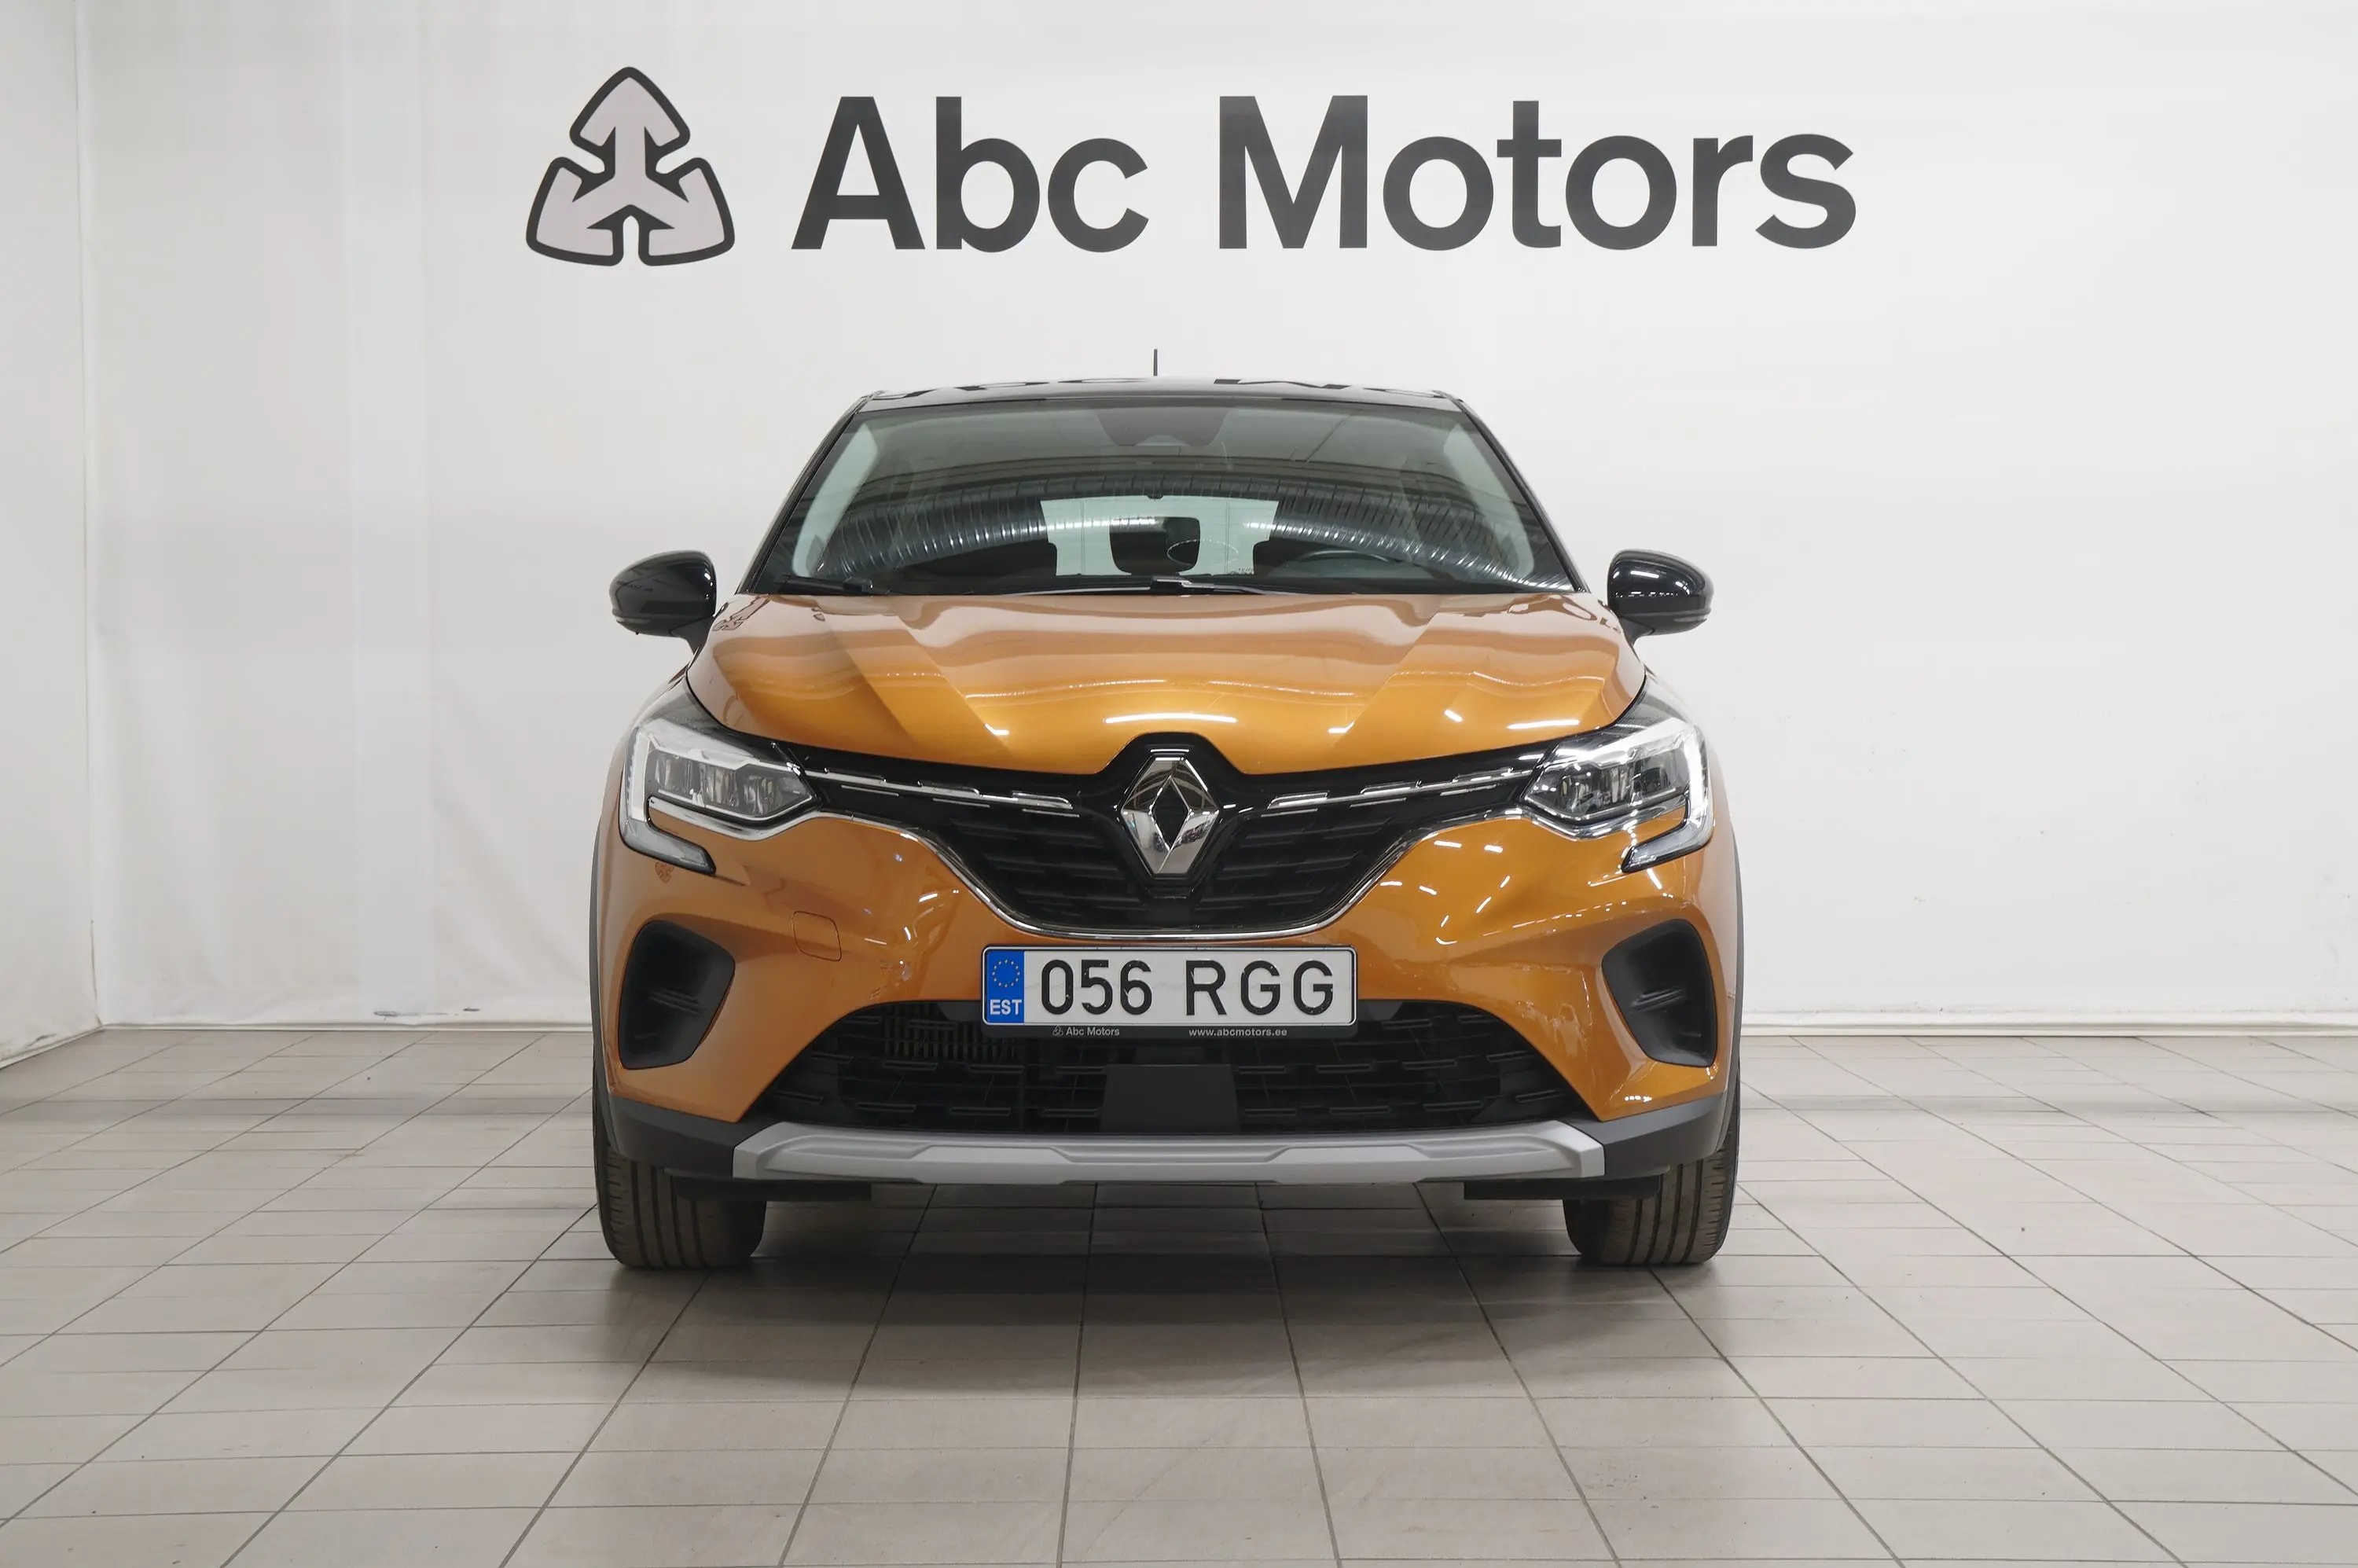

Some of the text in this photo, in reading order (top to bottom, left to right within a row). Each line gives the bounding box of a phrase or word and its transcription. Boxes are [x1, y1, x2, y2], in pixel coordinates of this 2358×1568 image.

[791, 95, 1857, 253] Abc Motors
[1041, 959, 1335, 1016] 056 RGG
[990, 999, 1023, 1015] EST
[1065, 1026, 1120, 1037] Abc Motors
[1188, 1027, 1288, 1037] www.abcmotors.ee
